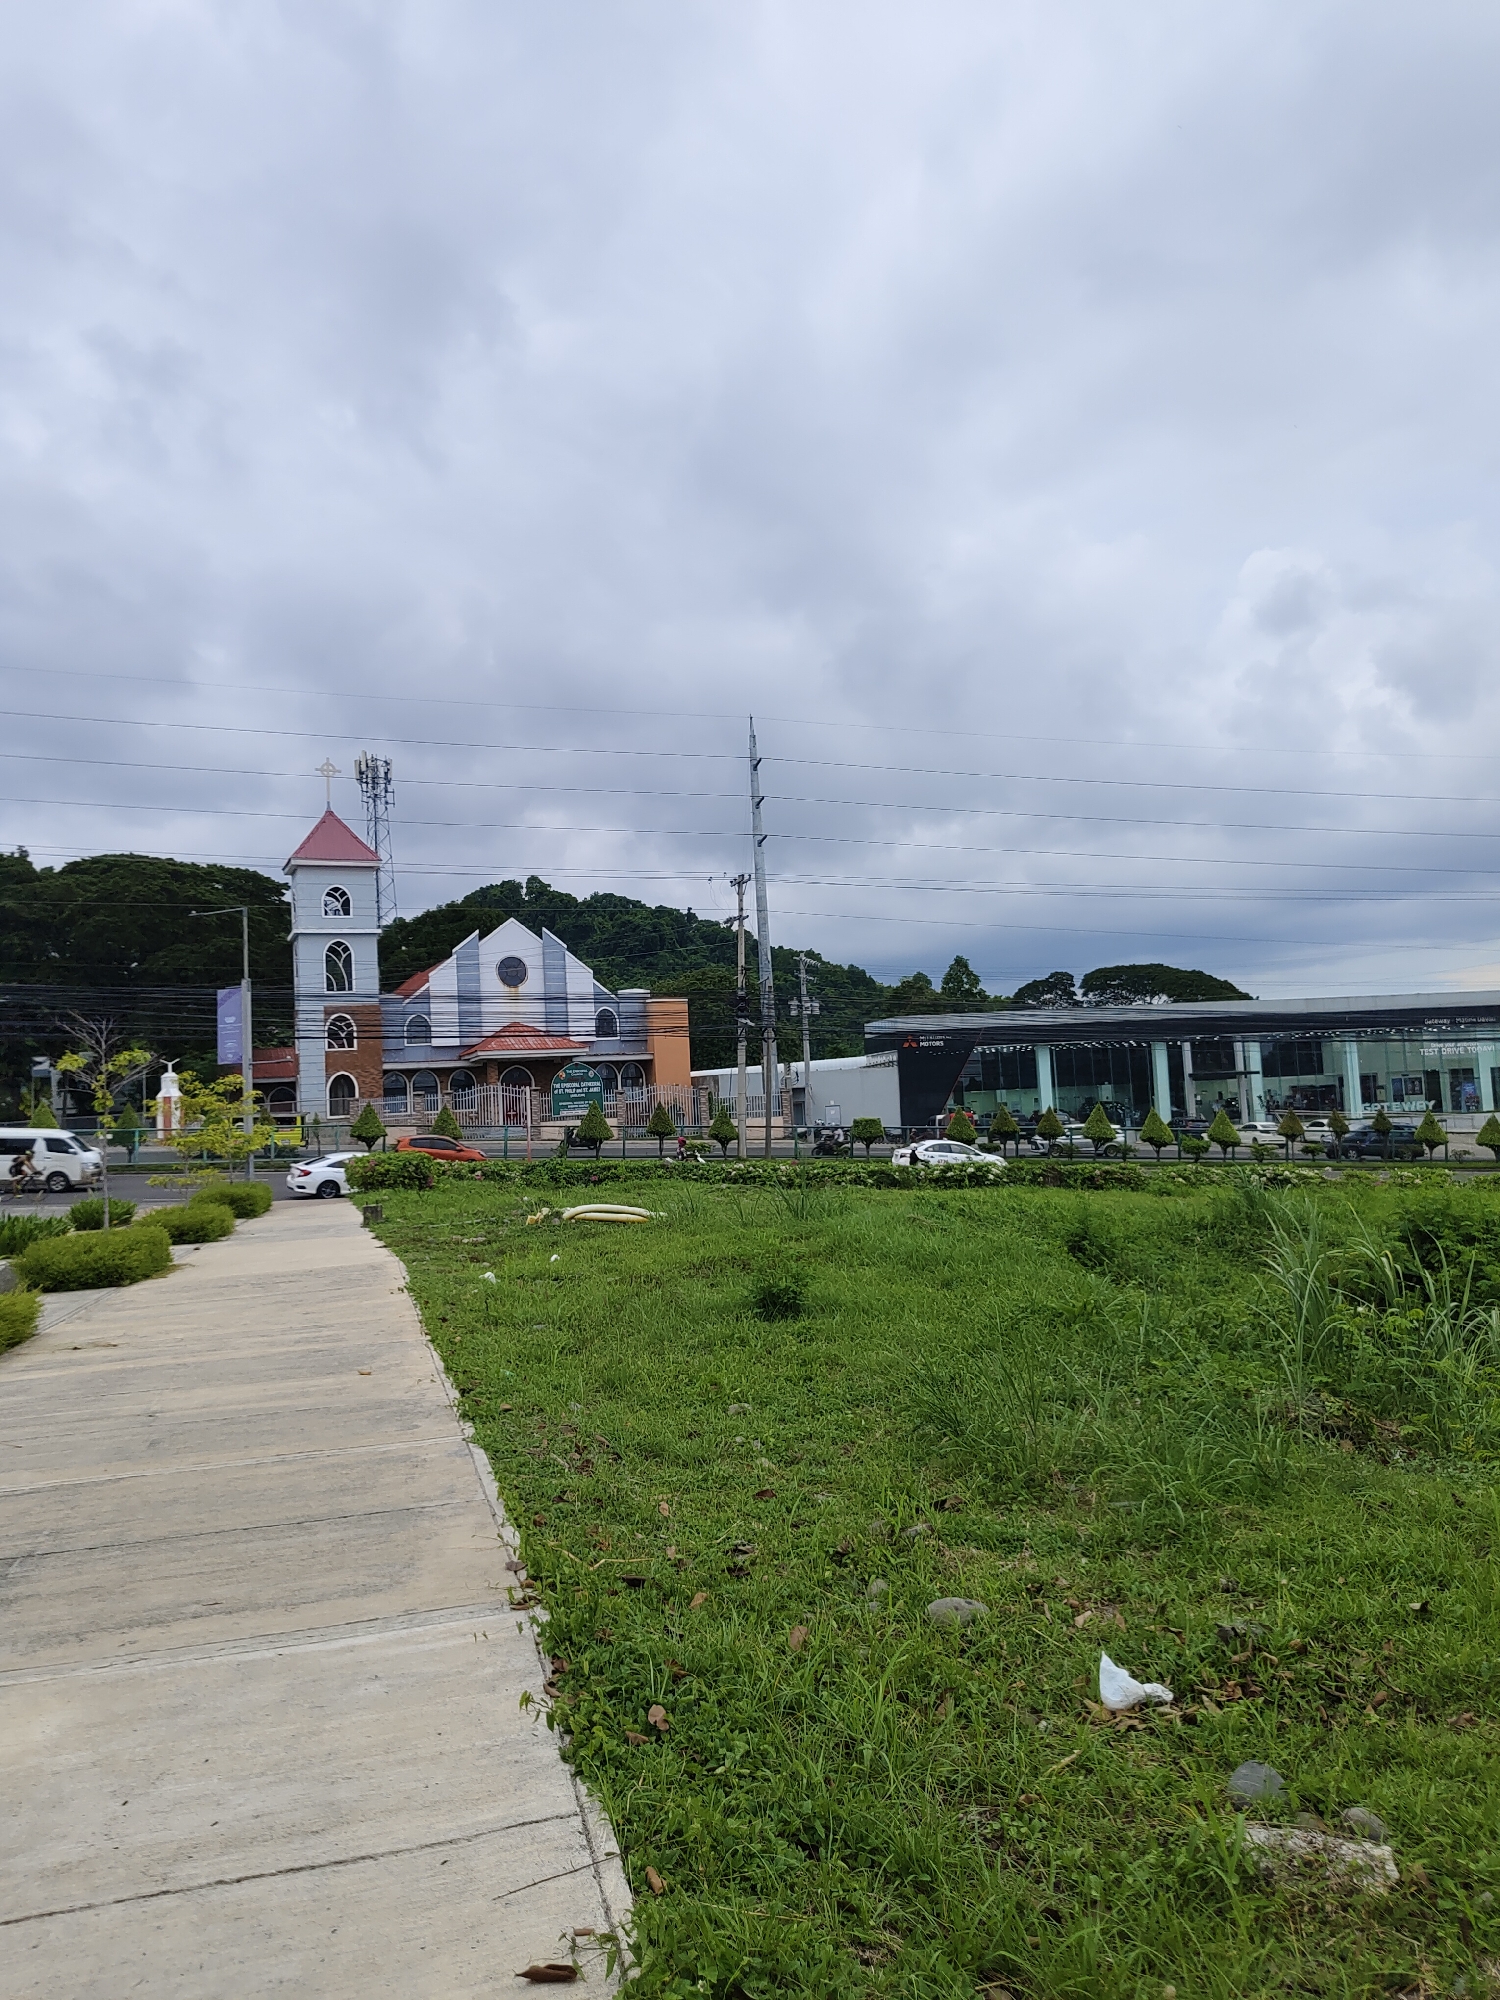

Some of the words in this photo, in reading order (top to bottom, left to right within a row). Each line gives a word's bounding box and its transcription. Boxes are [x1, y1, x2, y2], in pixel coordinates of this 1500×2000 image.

[1419, 1048, 1439, 1056] TEST
[1441, 1047, 1465, 1055] DRIVE
[1362, 1100, 1436, 1112] GATEWAY
